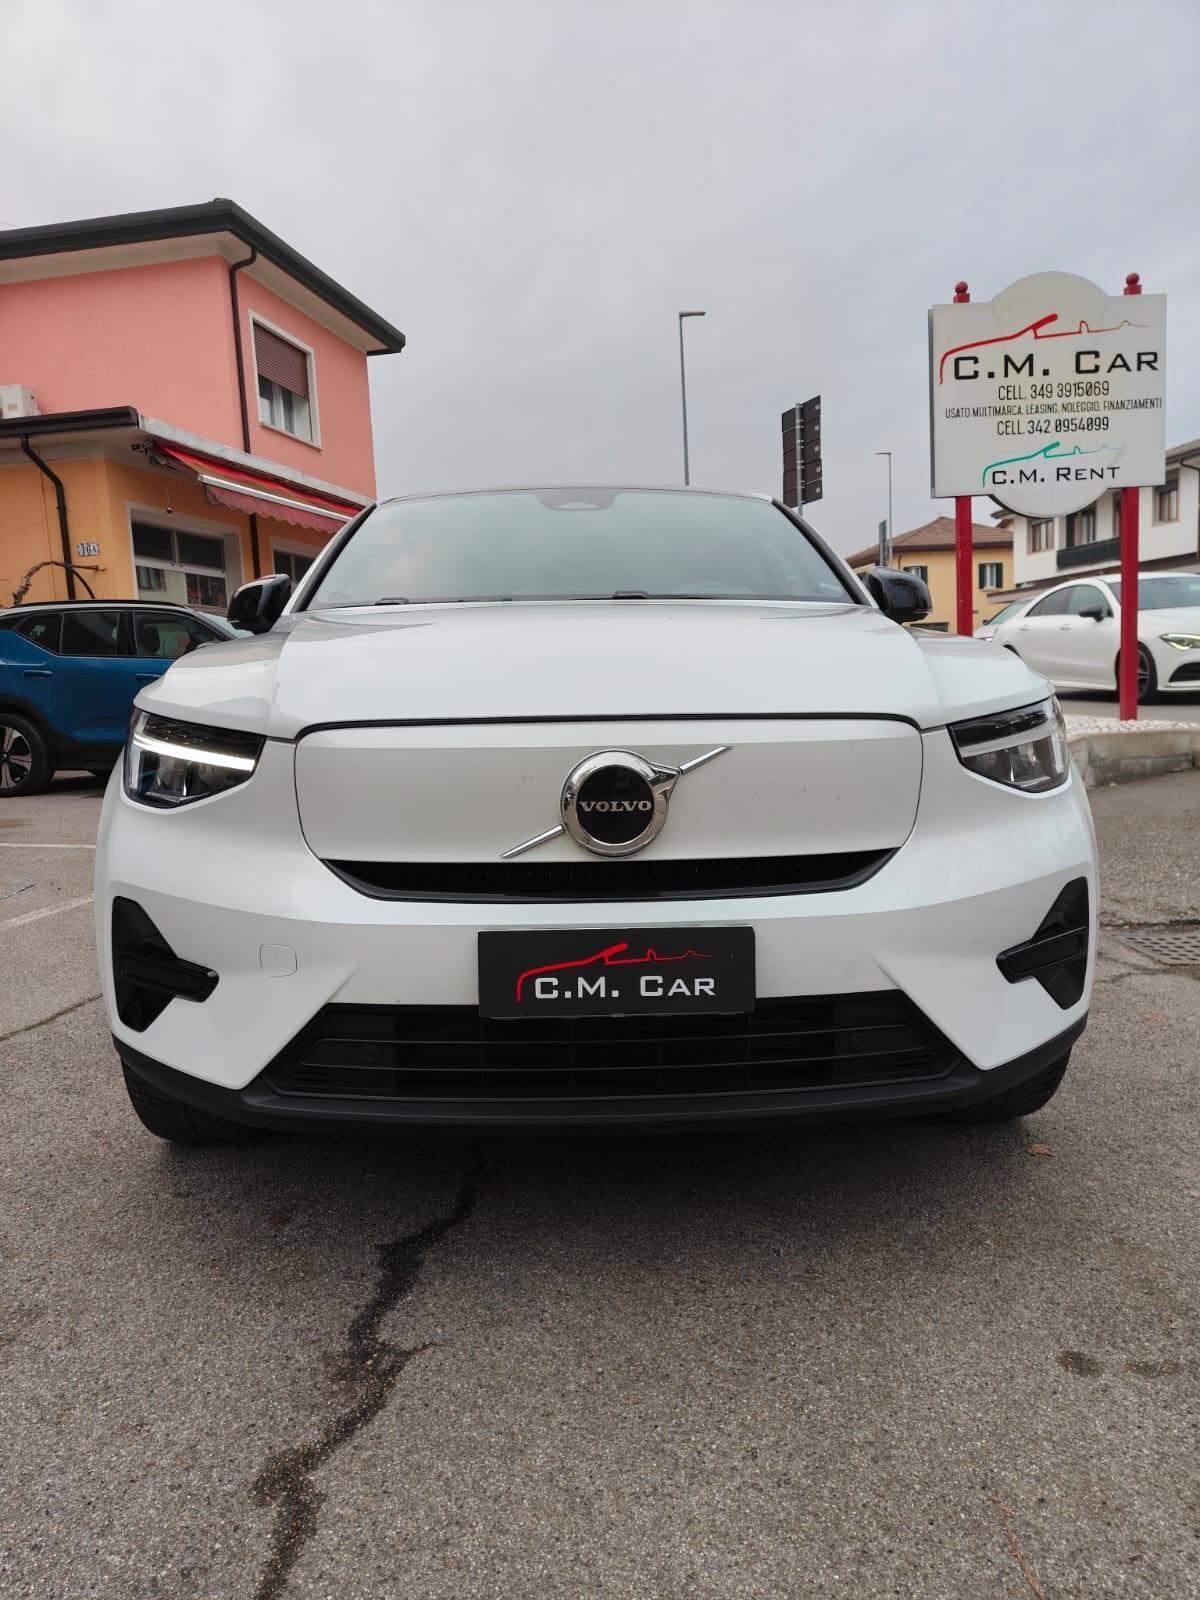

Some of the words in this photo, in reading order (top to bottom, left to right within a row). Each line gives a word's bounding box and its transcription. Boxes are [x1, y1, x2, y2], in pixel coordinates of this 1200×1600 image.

[953, 353, 1050, 380] C.M.
[998, 385, 1027, 401] CELL.
[1030, 384, 1053, 399] 349
[1057, 380, 1110, 398] 3915069
[945, 407, 971, 419] USATO
[1103, 397, 1162, 411] FINANZIAMENTI
[997, 420, 1025, 436] CELL.
[1027, 419, 1051, 435] 342
[1055, 416, 1109, 433] 0954099
[992, 469, 1045, 485] C.M.
[579, 800, 652, 812] VOLVO
[534, 976, 620, 999] C.M.
